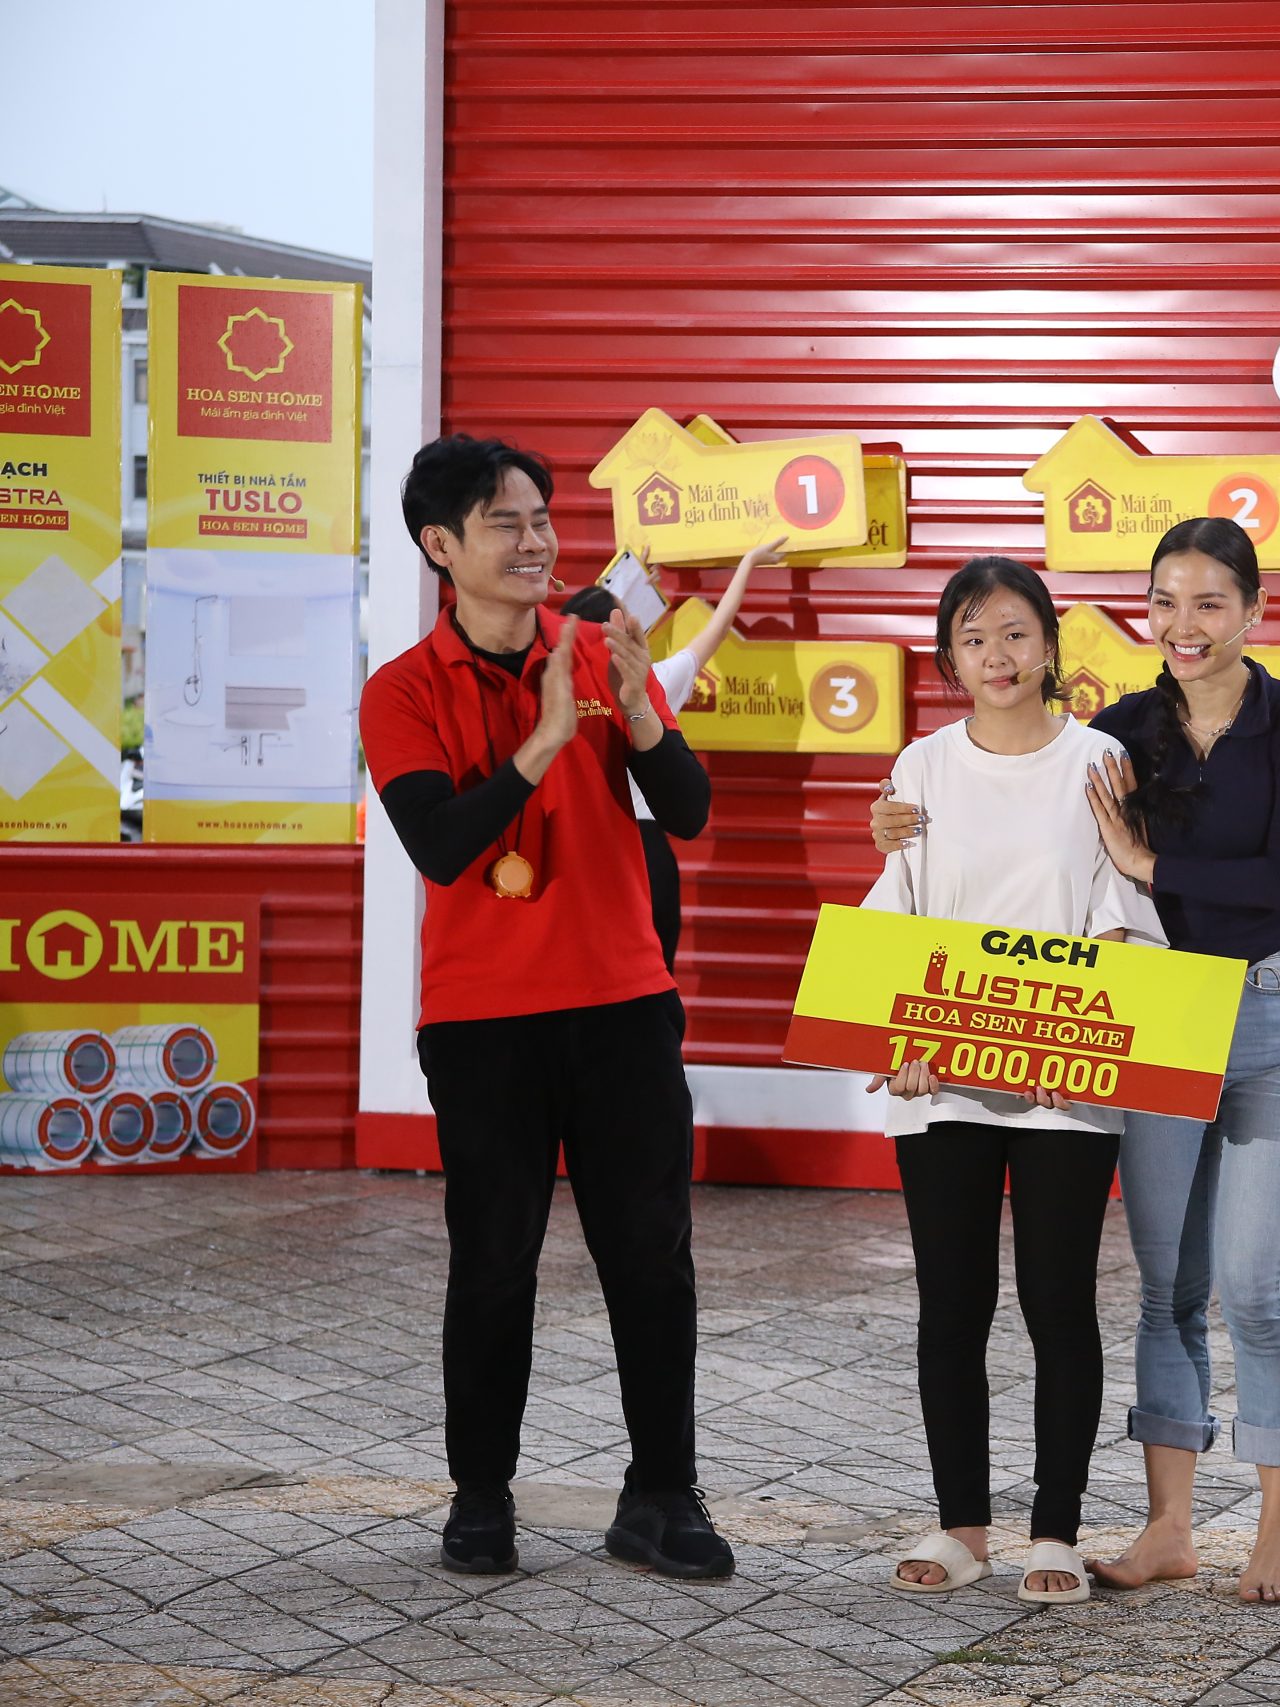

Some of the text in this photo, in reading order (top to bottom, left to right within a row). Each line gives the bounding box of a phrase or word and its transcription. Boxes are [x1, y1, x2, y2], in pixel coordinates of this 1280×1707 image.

[22, 384, 81, 399] HOME
[186, 388, 323, 407] HOA SEN HOME
[43, 404, 66, 417] Việt
[201, 407, 221, 417] Mái
[243, 409, 260, 421] gia
[286, 411, 308, 423] Việt
[0, 461, 48, 480] ẠCH
[197, 470, 230, 485] THIẾT
[233, 475, 245, 488] BỊ
[249, 474, 276, 487] NHÀ
[0, 487, 64, 506] STRA
[205, 488, 303, 515] TUSLO
[687, 484, 713, 504] Mái
[797, 474, 819, 515] 1
[1120, 493, 1146, 514] Mái
[684, 508, 705, 528] gia
[1228, 487, 1260, 529] 2
[0, 513, 67, 526] EN HOME
[202, 520, 305, 534] HOA SEN HOME
[1116, 516, 1137, 538] gia
[725, 675, 749, 696] Mái
[828, 676, 859, 718] 3
[719, 698, 741, 718] gia
[0, 819, 68, 830] asenhome.vn
[197, 818, 304, 831] www.hoasenhome.vn
[980, 929, 1100, 969] GẠCH
[922, 948, 1115, 1020] LUSTRA
[902, 1002, 1125, 1049] HOA SEN HOME
[889, 1034, 1120, 1098] 17.000.000
